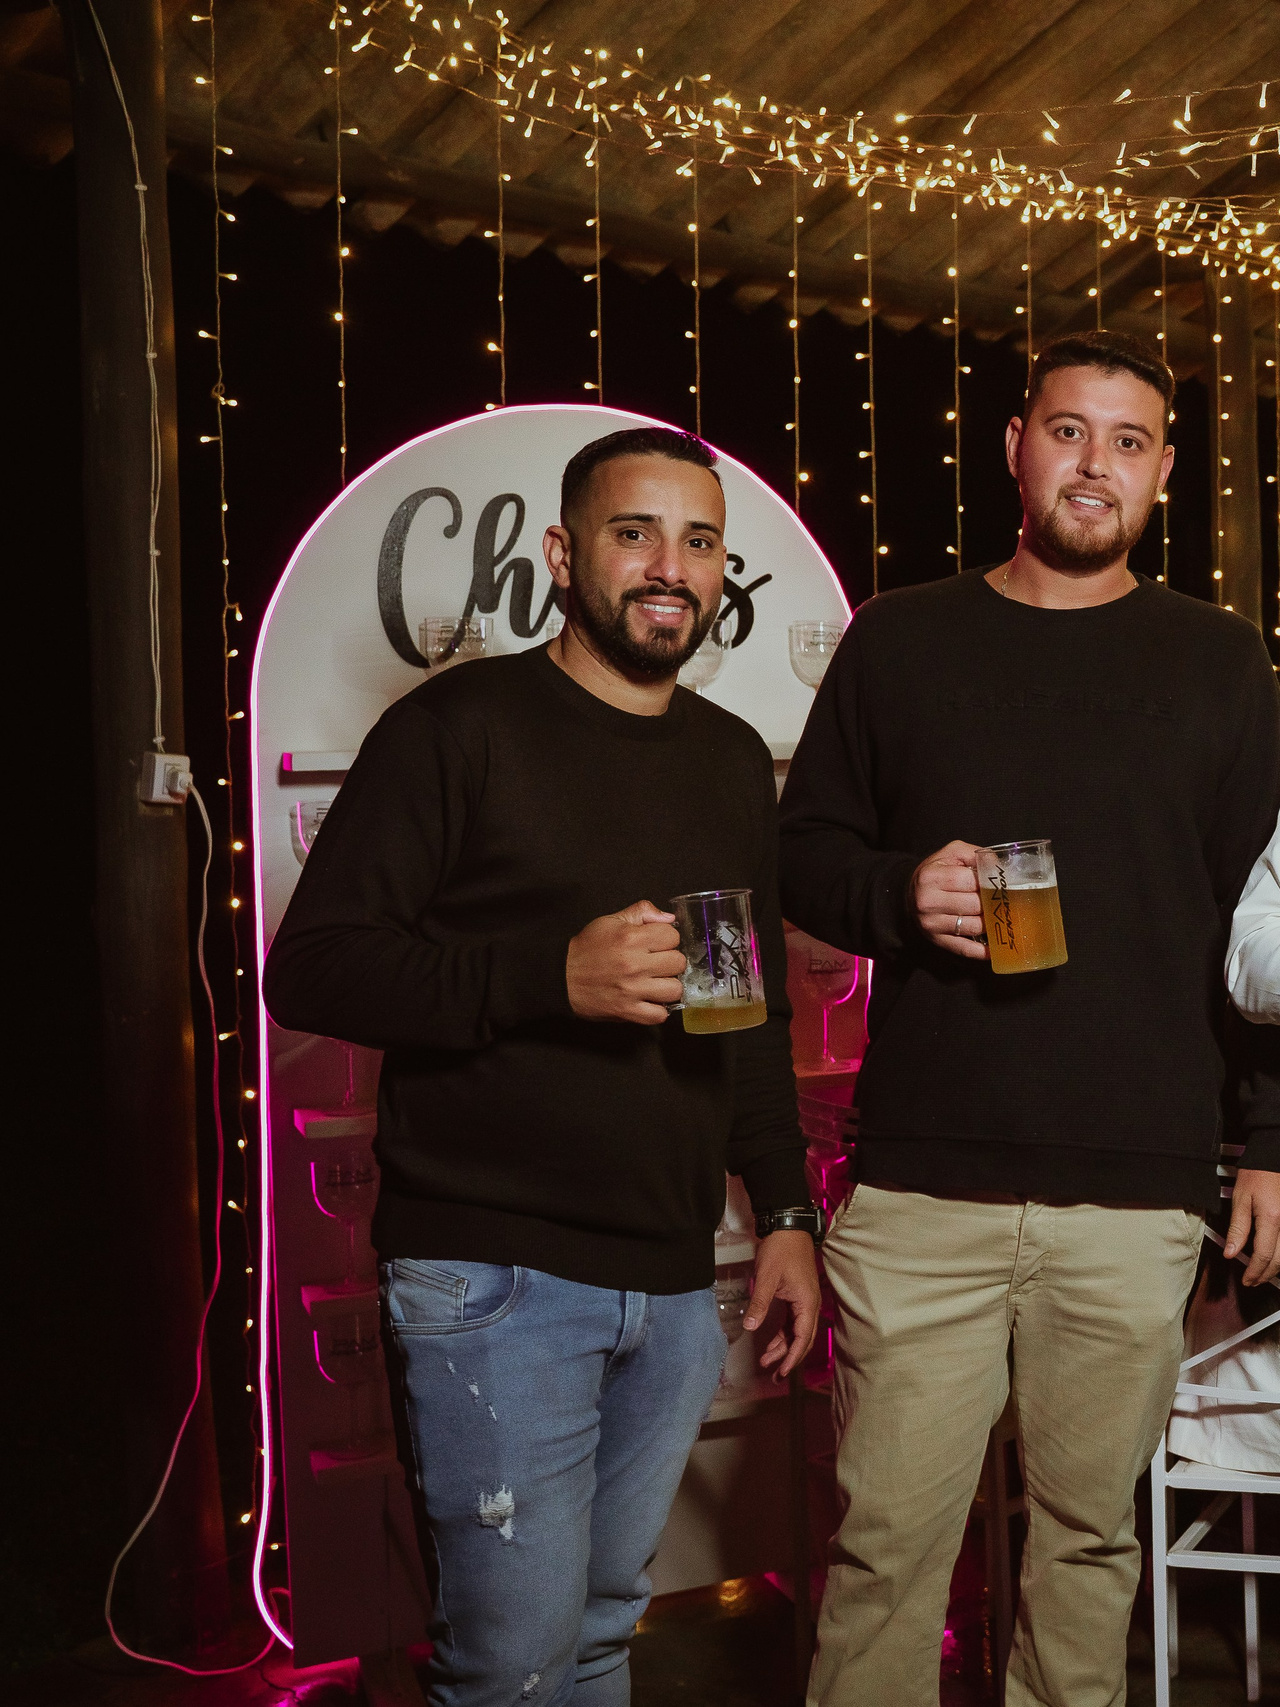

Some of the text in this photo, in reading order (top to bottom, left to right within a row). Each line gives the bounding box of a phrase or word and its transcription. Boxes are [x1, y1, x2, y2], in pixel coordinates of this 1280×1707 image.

[377, 487, 772, 668] Chs
[988, 876, 1007, 945] PAM
[995, 865, 1019, 954] SENSATION
[724, 925, 745, 999] PAM
